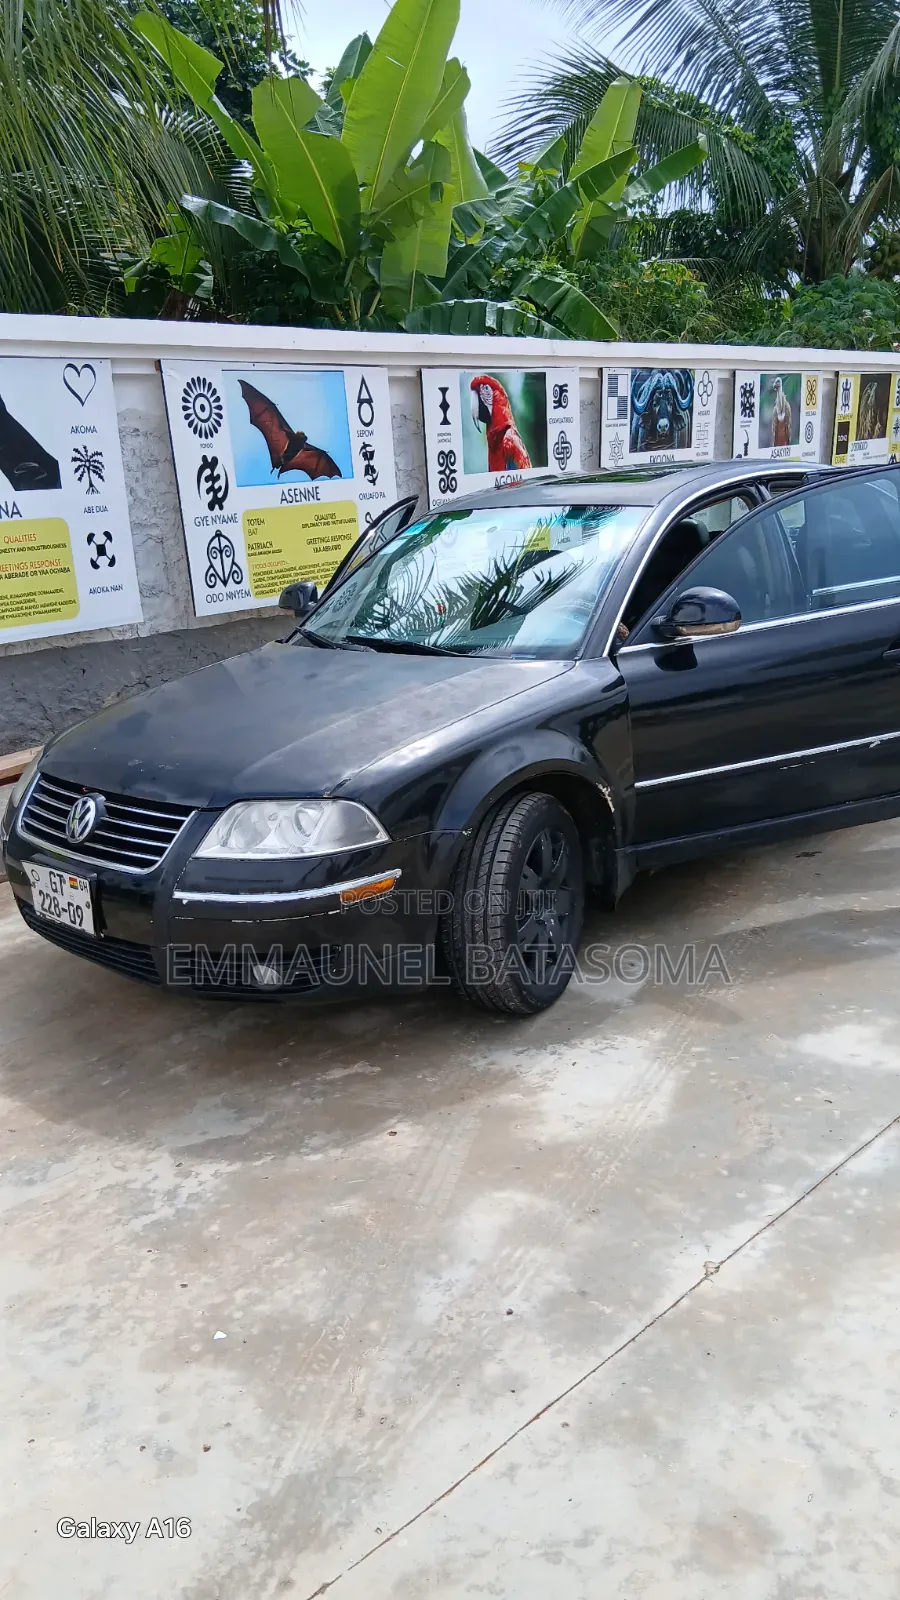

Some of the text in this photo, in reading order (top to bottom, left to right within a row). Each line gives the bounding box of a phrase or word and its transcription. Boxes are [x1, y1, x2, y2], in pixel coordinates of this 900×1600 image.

[70, 425, 98, 434] AKOMA
[356, 430, 374, 438] SEPOW
[280, 486, 321, 504] ASENNE
[83, 505, 108, 514] ABE DUA
[194, 513, 238, 527] GYE NYAME
[248, 528, 258, 536] BAT
[4, 533, 36, 544] QUALITIES
[30, 558, 62, 569] RESPONSE
[206, 592, 224, 603] ODO
[49, 871, 64, 896] GT
[39, 889, 84, 927] 228-09
